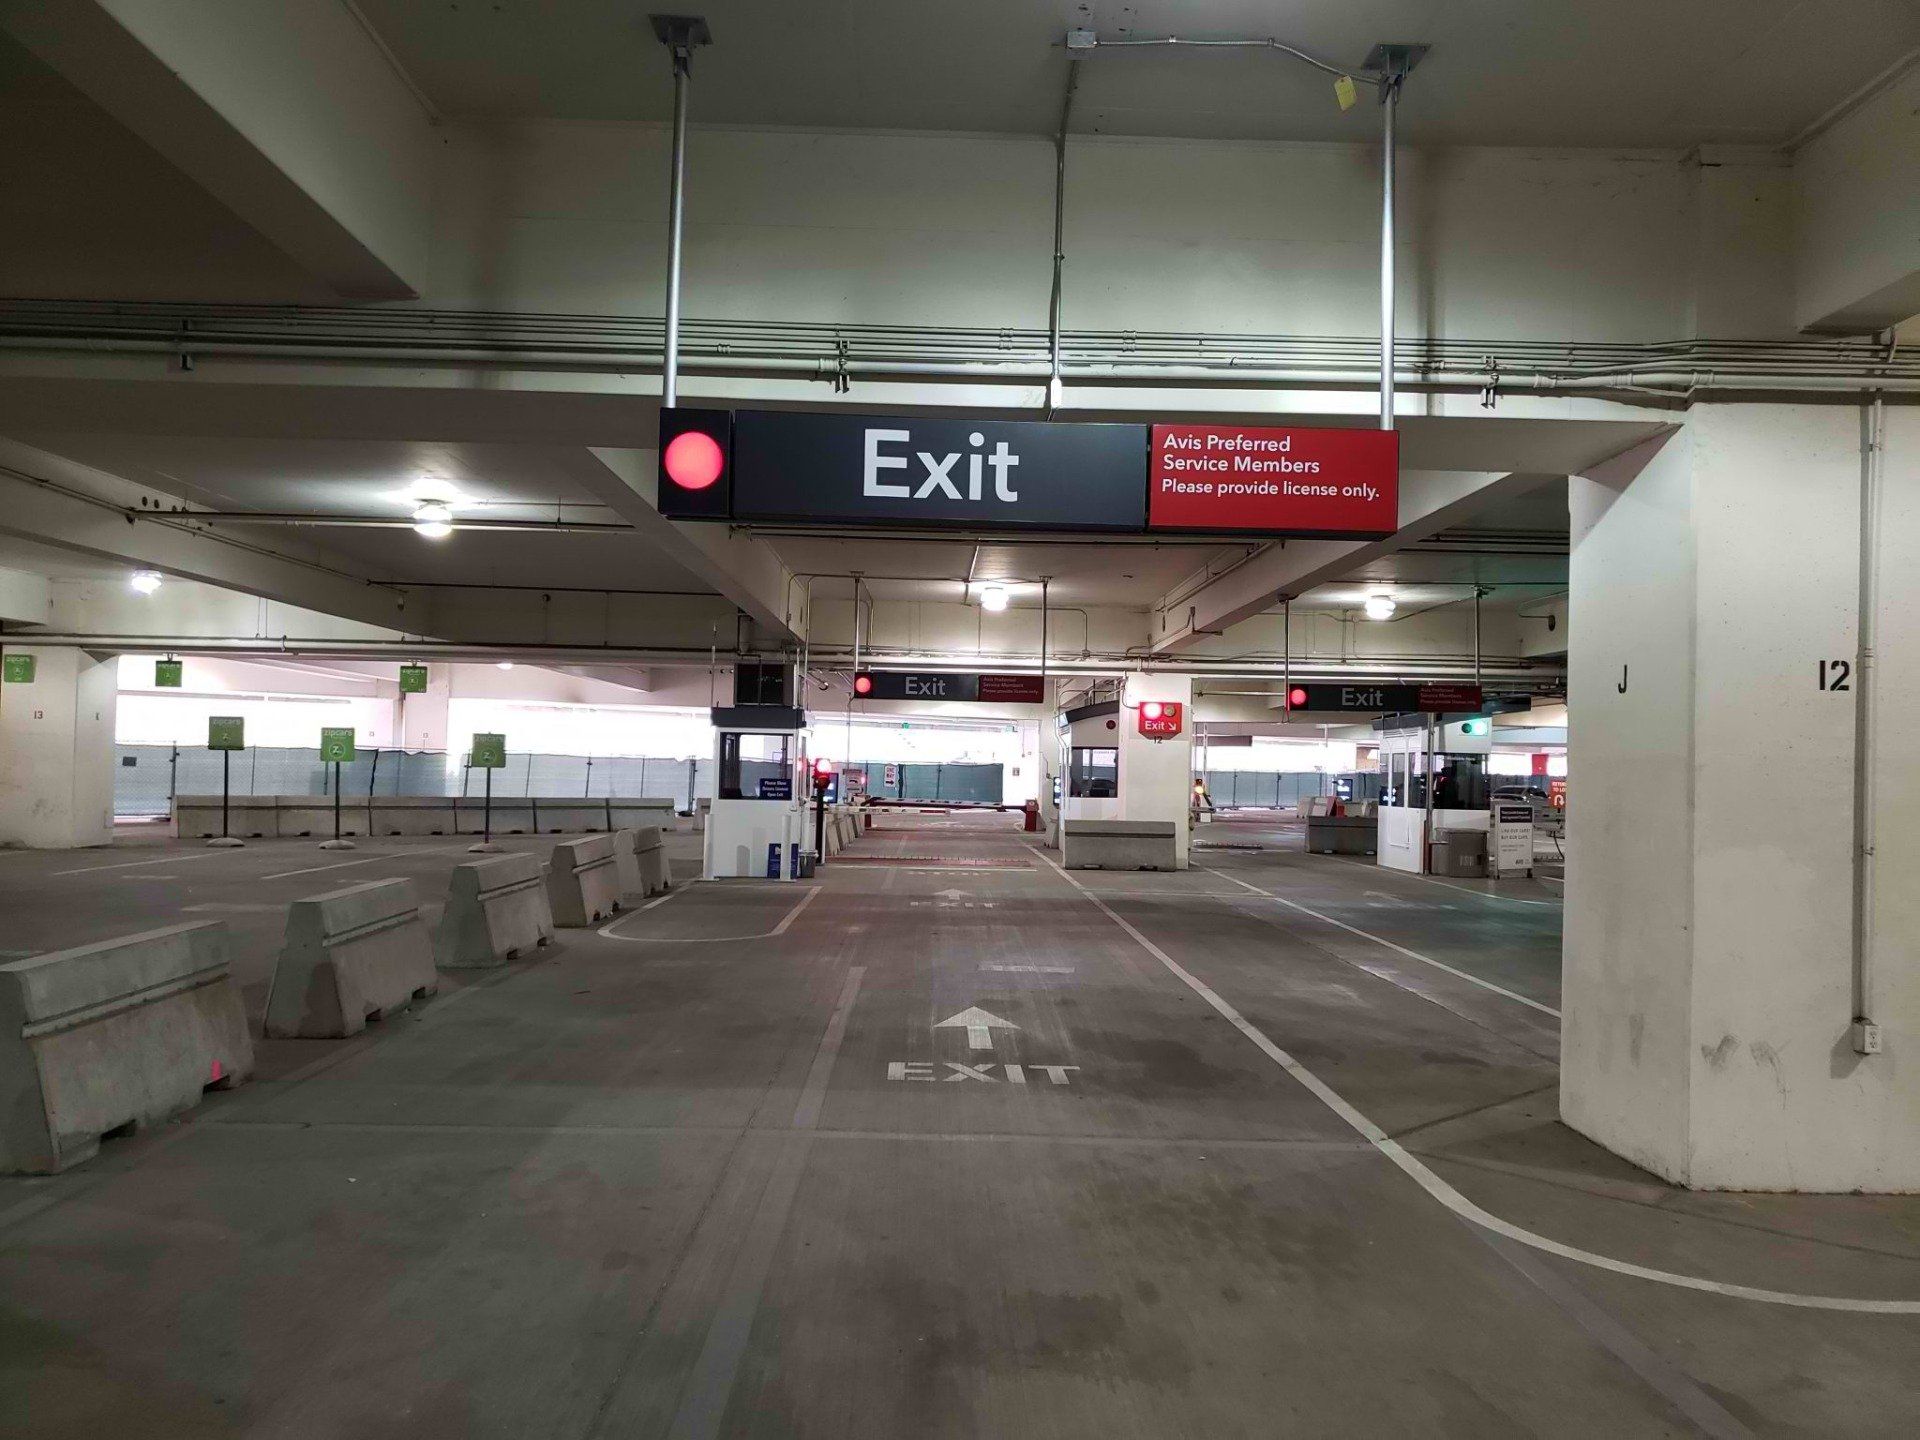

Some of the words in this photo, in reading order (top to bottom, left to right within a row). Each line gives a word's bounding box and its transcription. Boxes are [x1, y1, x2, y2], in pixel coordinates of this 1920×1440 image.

[1163, 433, 1202, 450] Avis
[1207, 434, 1291, 452] Preferred
[863, 428, 1019, 502] Exit
[1163, 454, 1228, 471] Service
[1234, 456, 1320, 473] Members
[1162, 478, 1213, 493] Please
[1218, 480, 1279, 497] provide
[1283, 481, 1338, 496] license
[1342, 482, 1380, 501] only.
[1618, 664, 1628, 693] J
[1819, 660, 1850, 691] 12
[905, 677, 946, 696] Exit
[1342, 687, 1383, 706] Exit
[34, 711, 43, 719] 13
[323, 729, 353, 738] zipcars
[1145, 720, 1165, 730] Exit
[888, 1061, 1081, 1085] EXIT
